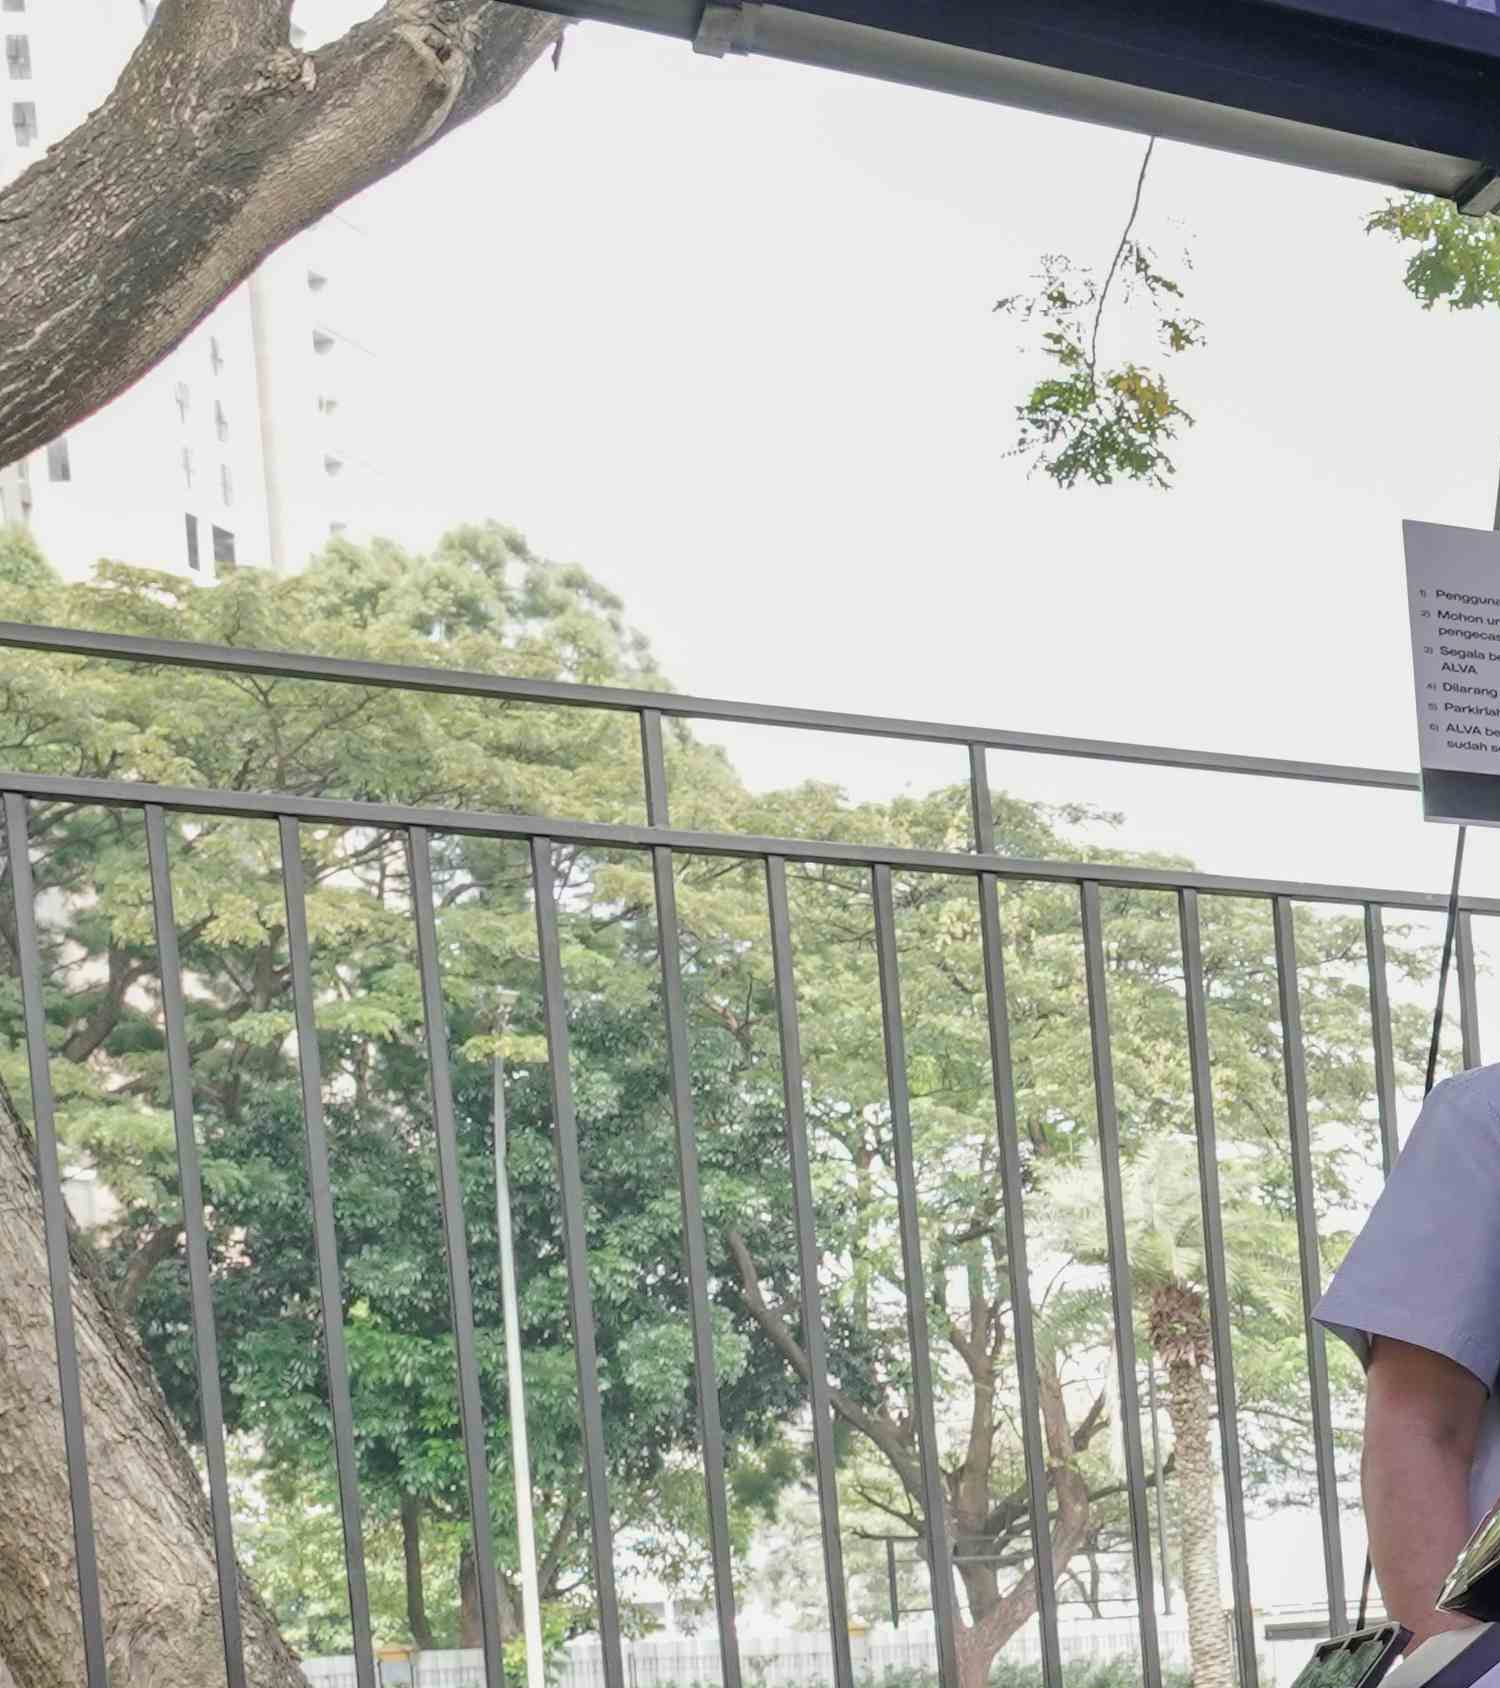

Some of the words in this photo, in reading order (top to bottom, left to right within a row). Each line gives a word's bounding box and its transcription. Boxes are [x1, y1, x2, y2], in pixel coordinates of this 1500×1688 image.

[1437, 609, 1484, 626] Mohon
[1439, 645, 1486, 662] Segala
[1441, 662, 1479, 676] ALVA
[1442, 681, 1498, 699] Dilarang
[1445, 722, 1482, 737] ALVA
[1446, 739, 1488, 753] sudah
